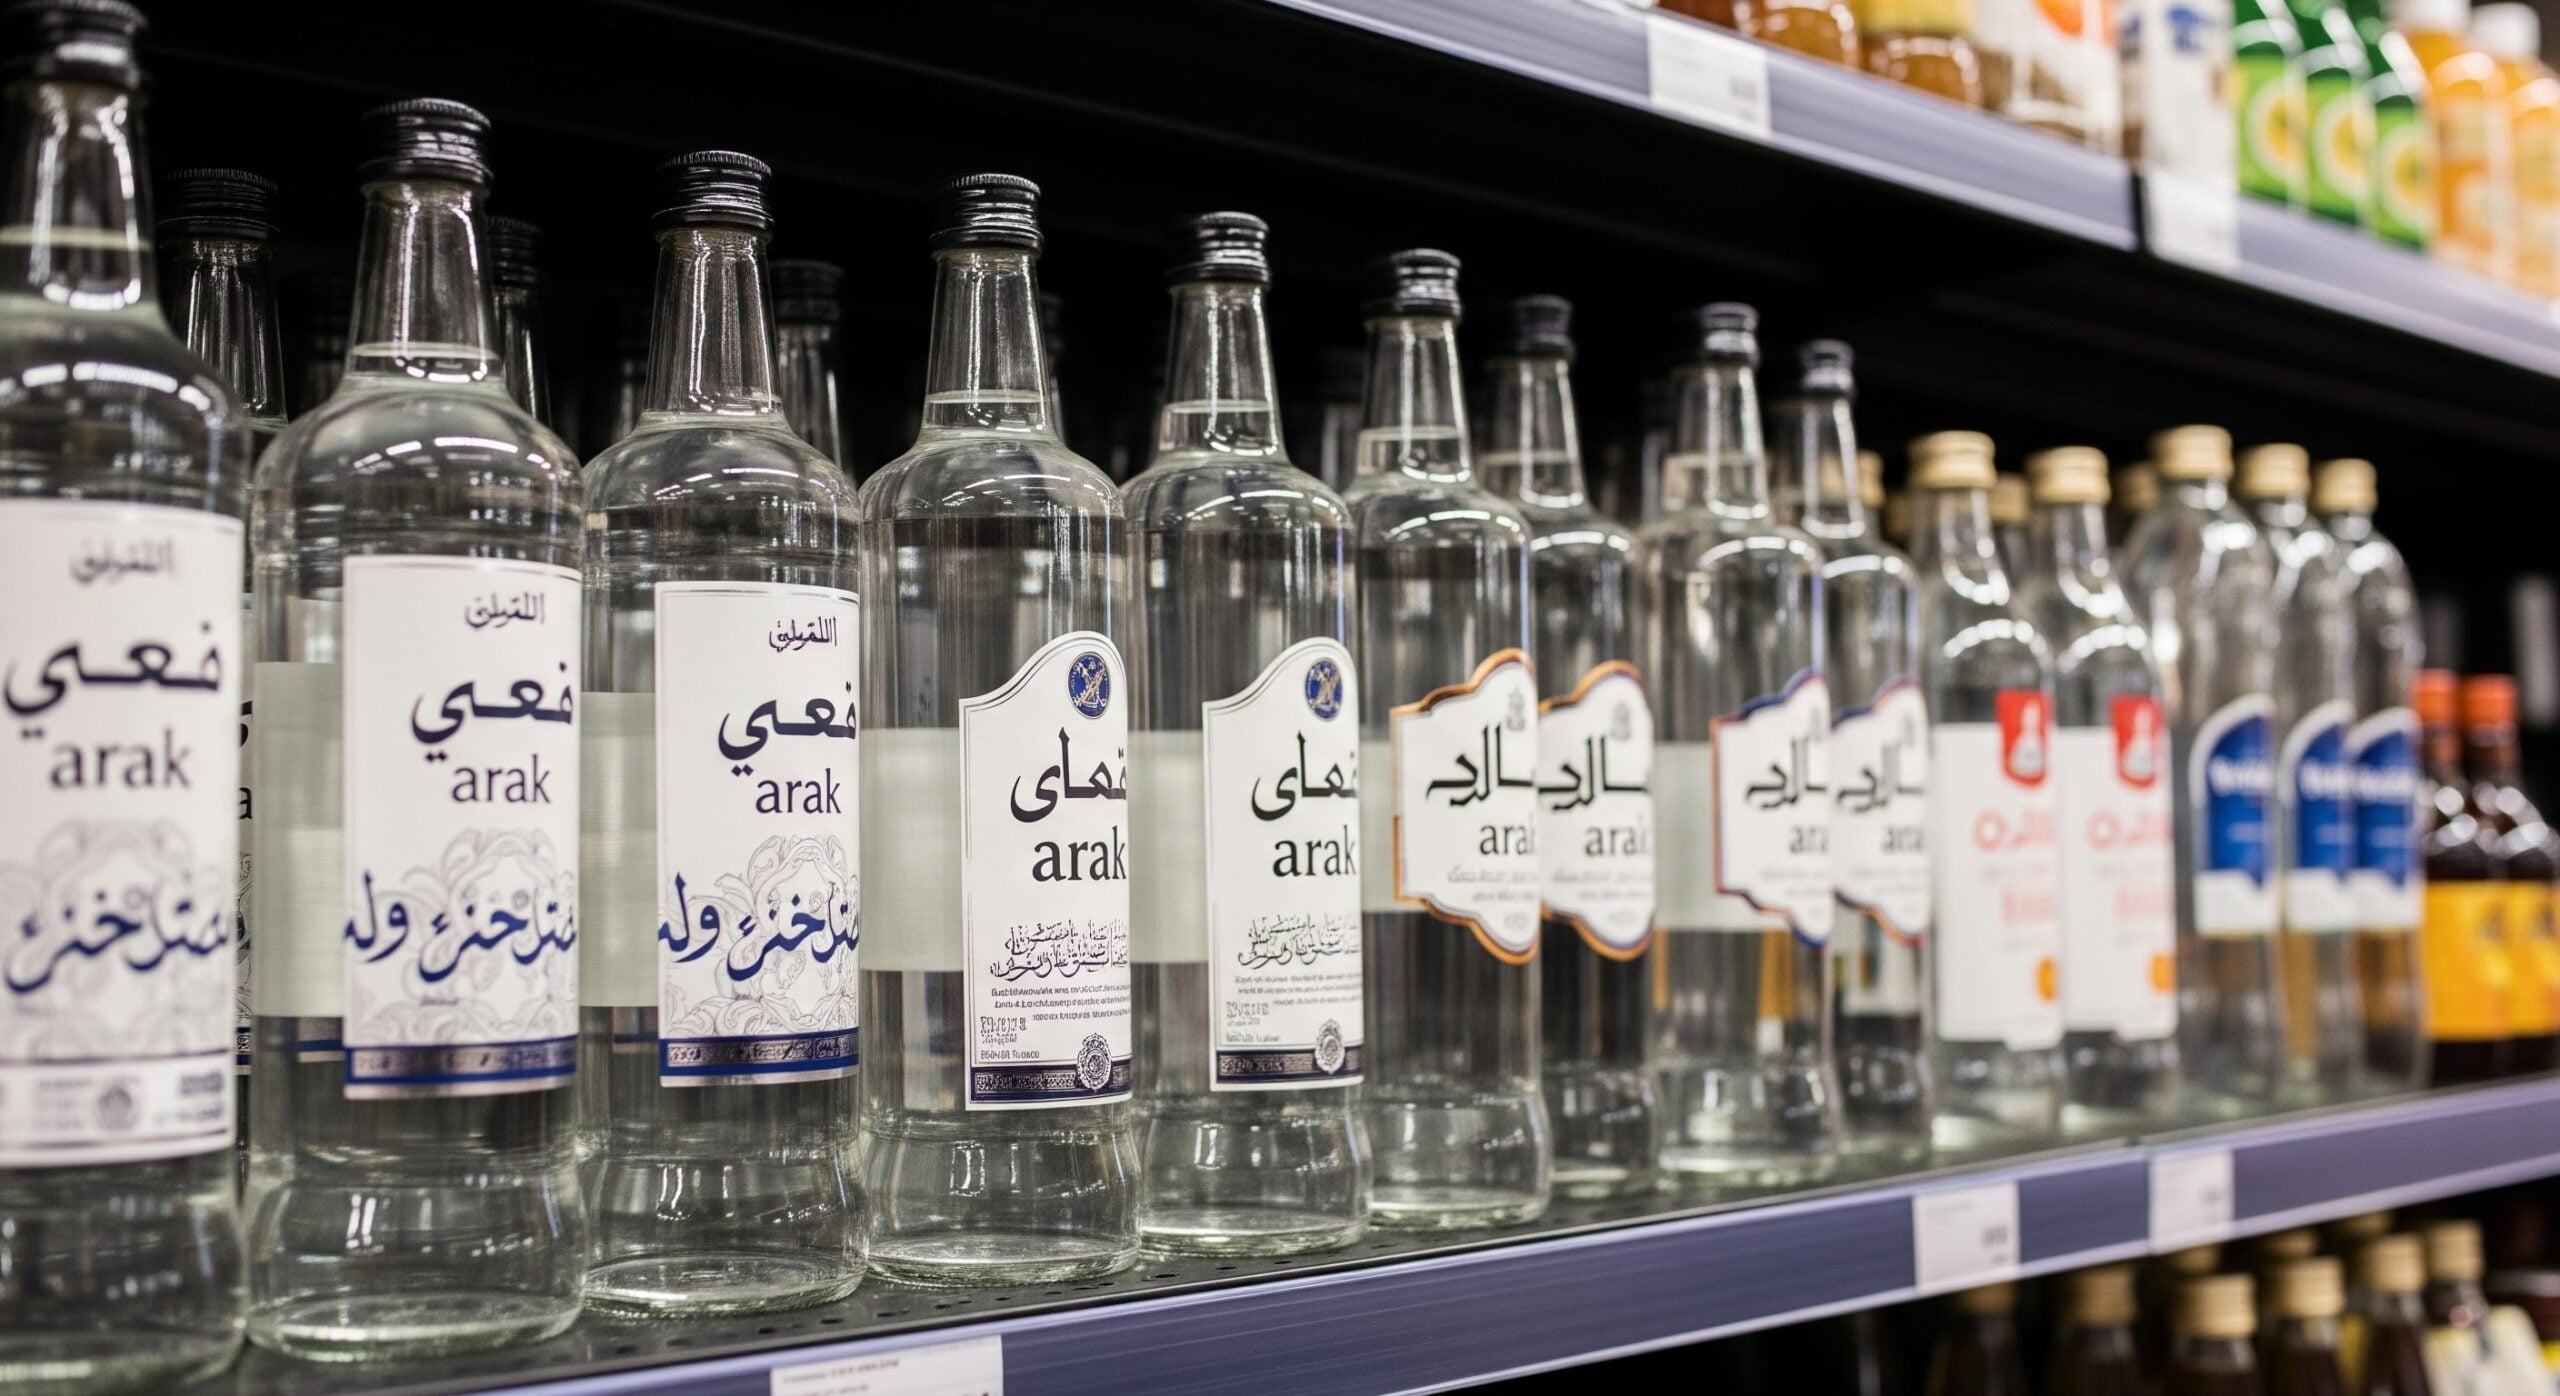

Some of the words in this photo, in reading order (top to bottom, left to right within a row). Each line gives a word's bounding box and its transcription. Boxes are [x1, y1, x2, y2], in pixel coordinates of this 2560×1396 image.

[50, 727, 193, 788] arak
[452, 753, 552, 803] arak
[755, 767, 842, 814] arak
[1032, 825, 1128, 882] arak
[1272, 824, 1358, 877] arak
